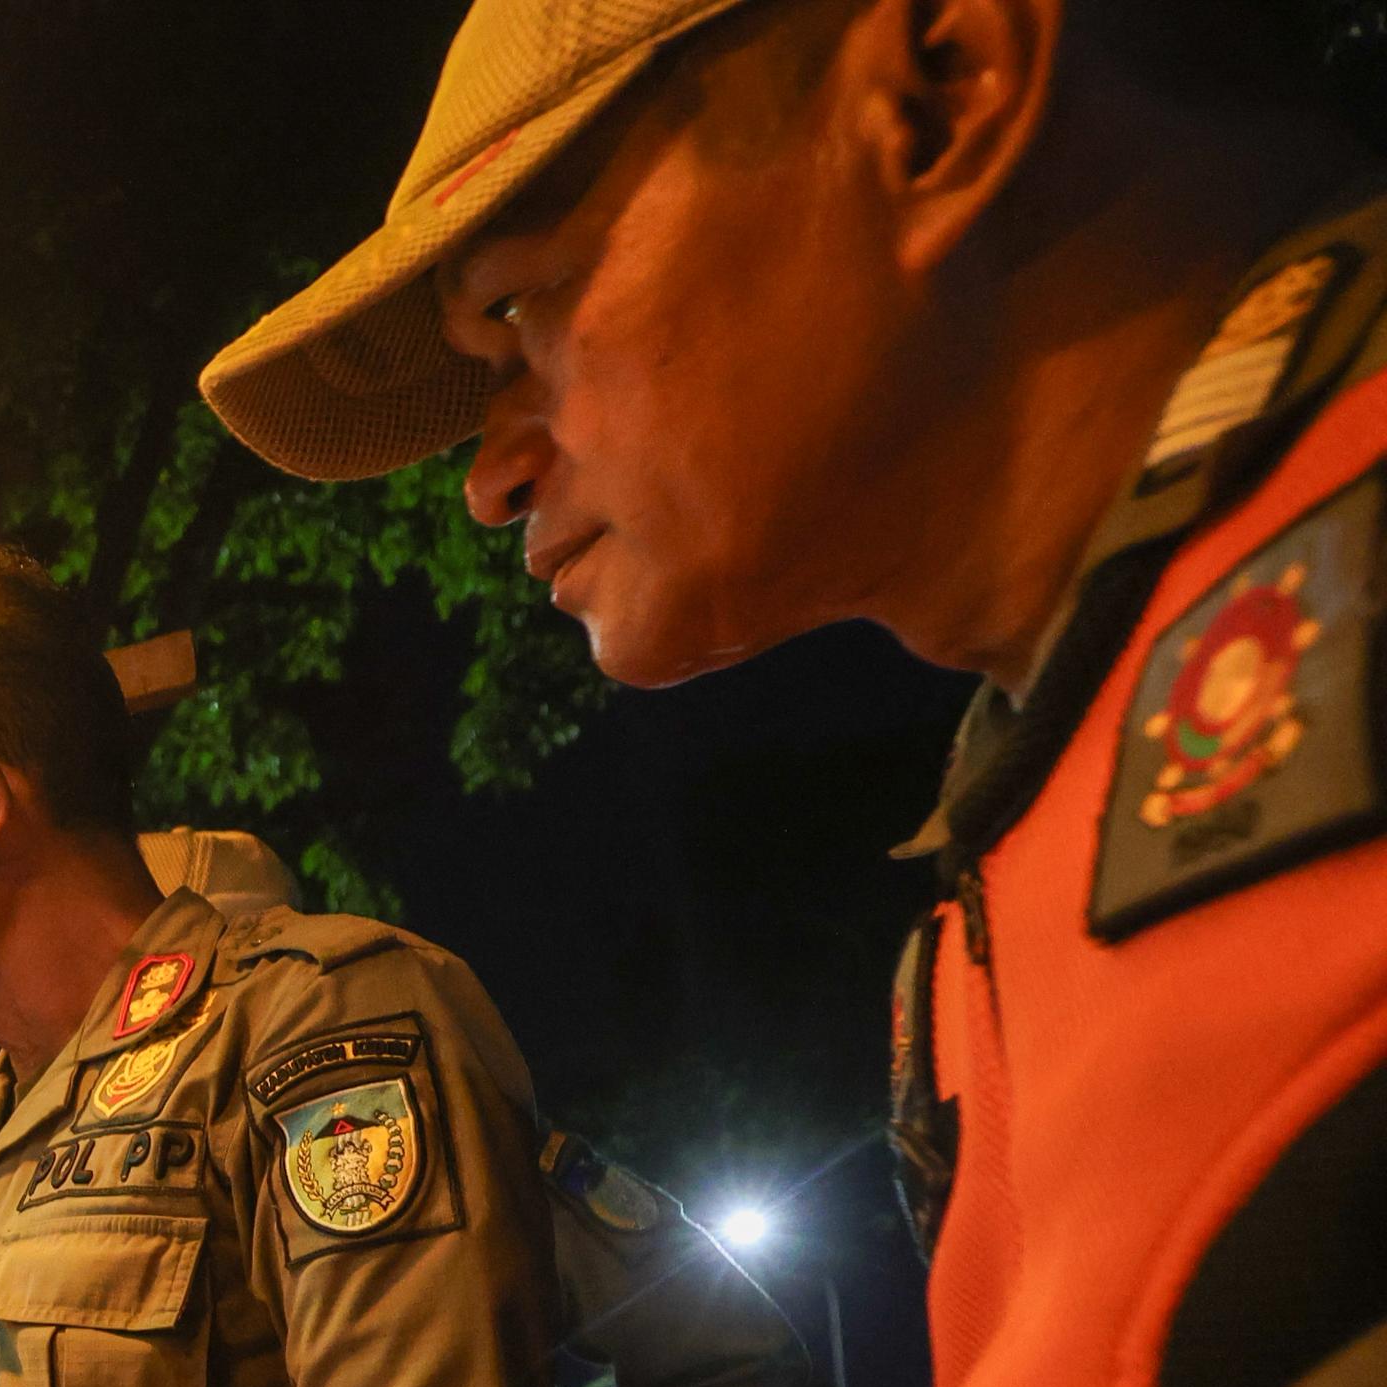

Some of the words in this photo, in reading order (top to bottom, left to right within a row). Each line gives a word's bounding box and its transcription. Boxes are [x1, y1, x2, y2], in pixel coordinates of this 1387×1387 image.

[258, 1043, 346, 1097] KABUPATEN
[28, 1138, 95, 1196] POL
[121, 1131, 196, 1182] PP
